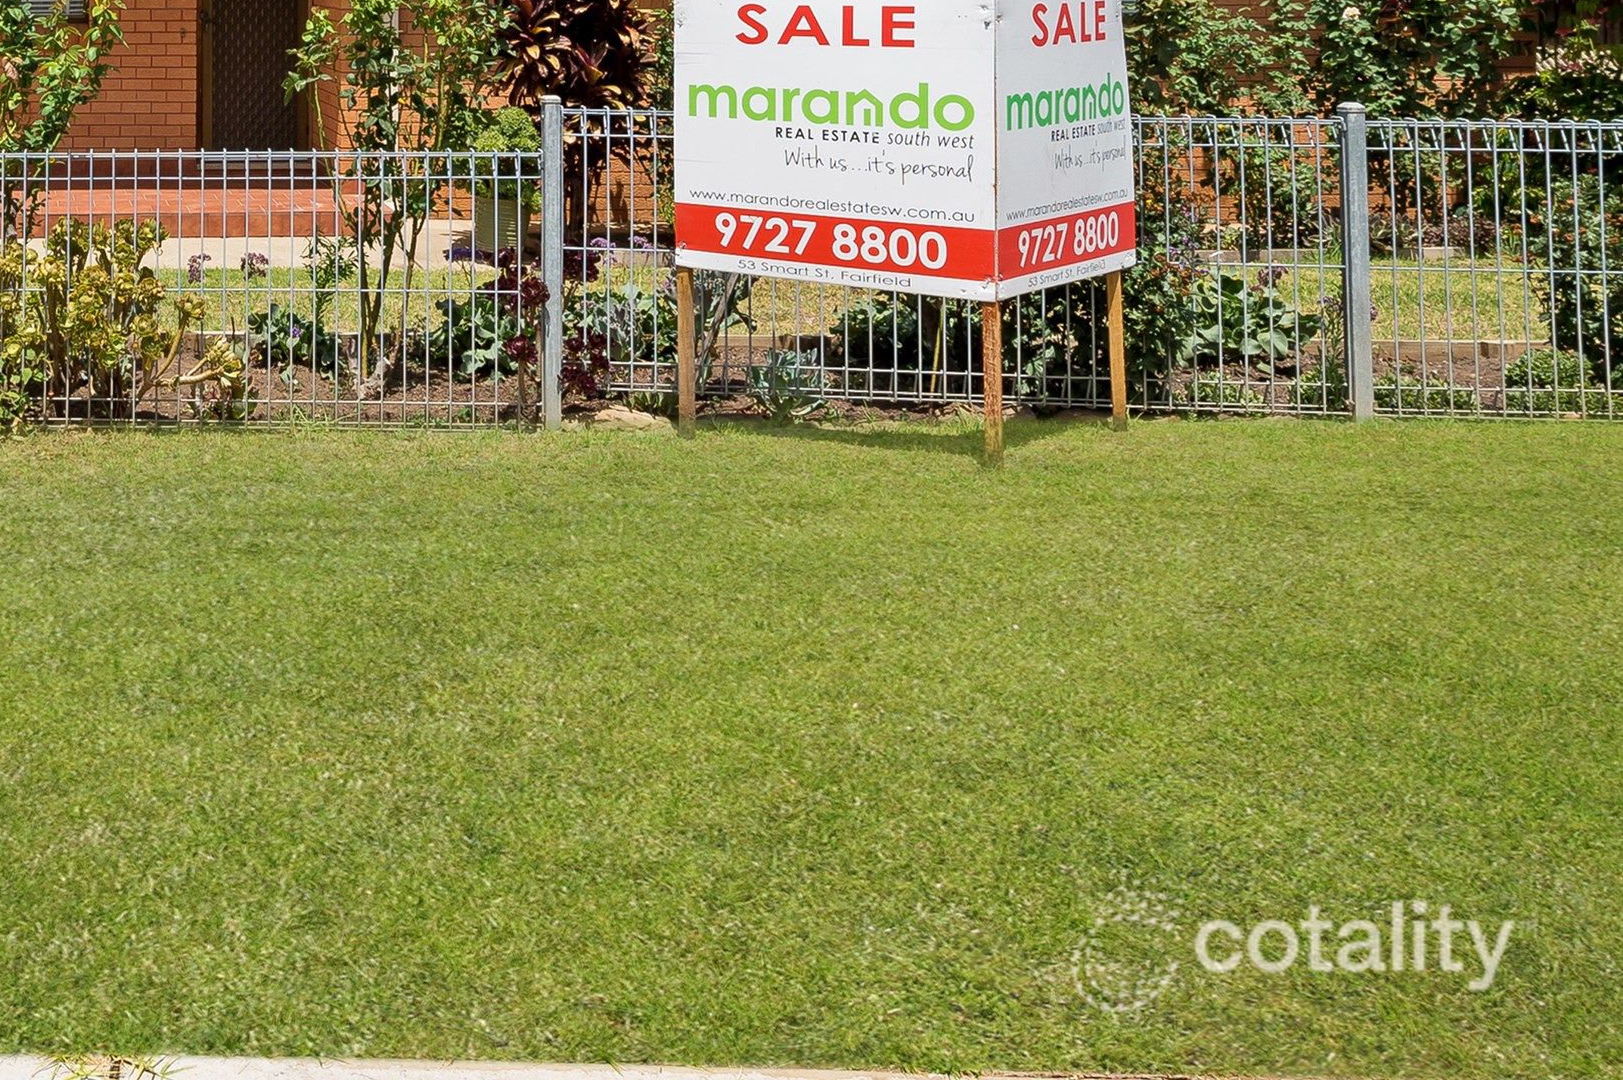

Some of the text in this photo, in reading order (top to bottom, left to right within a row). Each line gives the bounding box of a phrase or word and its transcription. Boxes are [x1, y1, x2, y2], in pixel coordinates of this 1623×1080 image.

[735, 3, 916, 48] SALE
[1031, 0, 1106, 47] SALE
[688, 82, 975, 132] marando
[1006, 72, 1125, 131] marando
[775, 126, 974, 149] REAL ESTATE south west
[1051, 129, 1070, 142] REAL
[1071, 124, 1095, 139] ESTATE
[784, 145, 825, 168] With
[900, 154, 975, 186] personal
[689, 188, 975, 223] www.marandorealestatesw.com.au
[1006, 187, 1128, 221] www.marandorealestatesw.com.au
[714, 212, 948, 270] 9727 8800
[1018, 211, 1119, 268] 9727 8800
[737, 259, 757, 270] 53
[761, 261, 809, 277] Smart
[840, 271, 912, 287] Fairfield
[1028, 276, 1038, 288] 53
[1039, 270, 1064, 285] Smart
[1076, 259, 1106, 276] Fairfield
